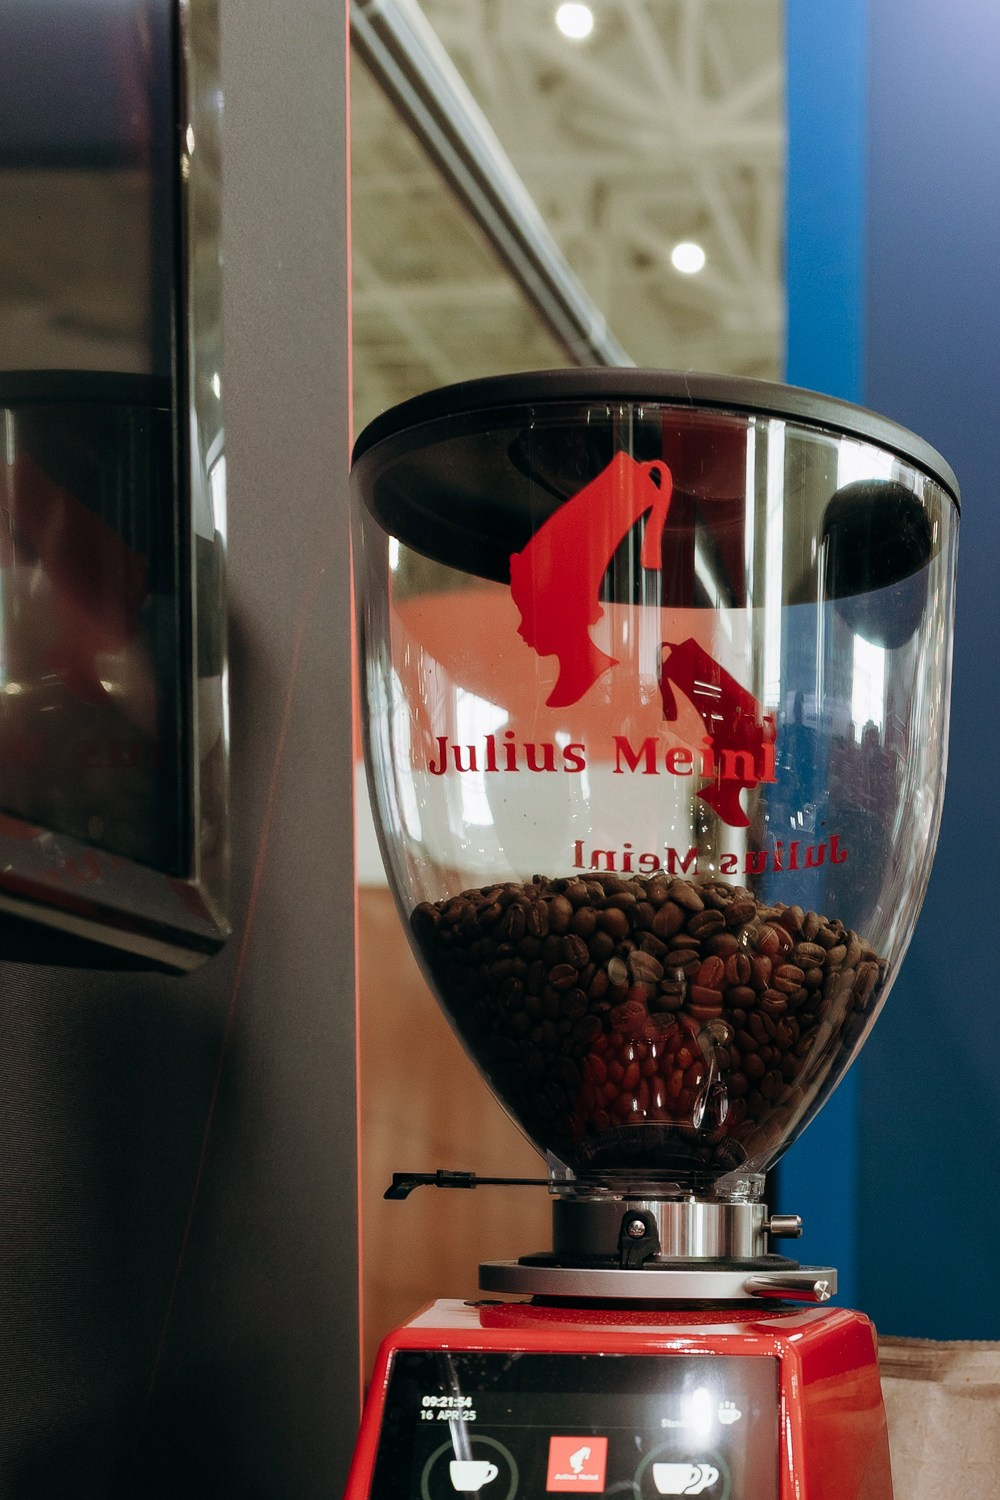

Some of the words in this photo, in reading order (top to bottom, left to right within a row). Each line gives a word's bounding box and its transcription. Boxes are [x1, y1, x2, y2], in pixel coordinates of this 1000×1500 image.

[429, 731, 586, 776] Julius
[613, 736, 777, 783] Meinl
[422, 1396, 473, 1409] 09:21:54
[420, 1409, 434, 1421] 16
[436, 1410, 460, 1421] APR
[462, 1410, 477, 1422] 25
